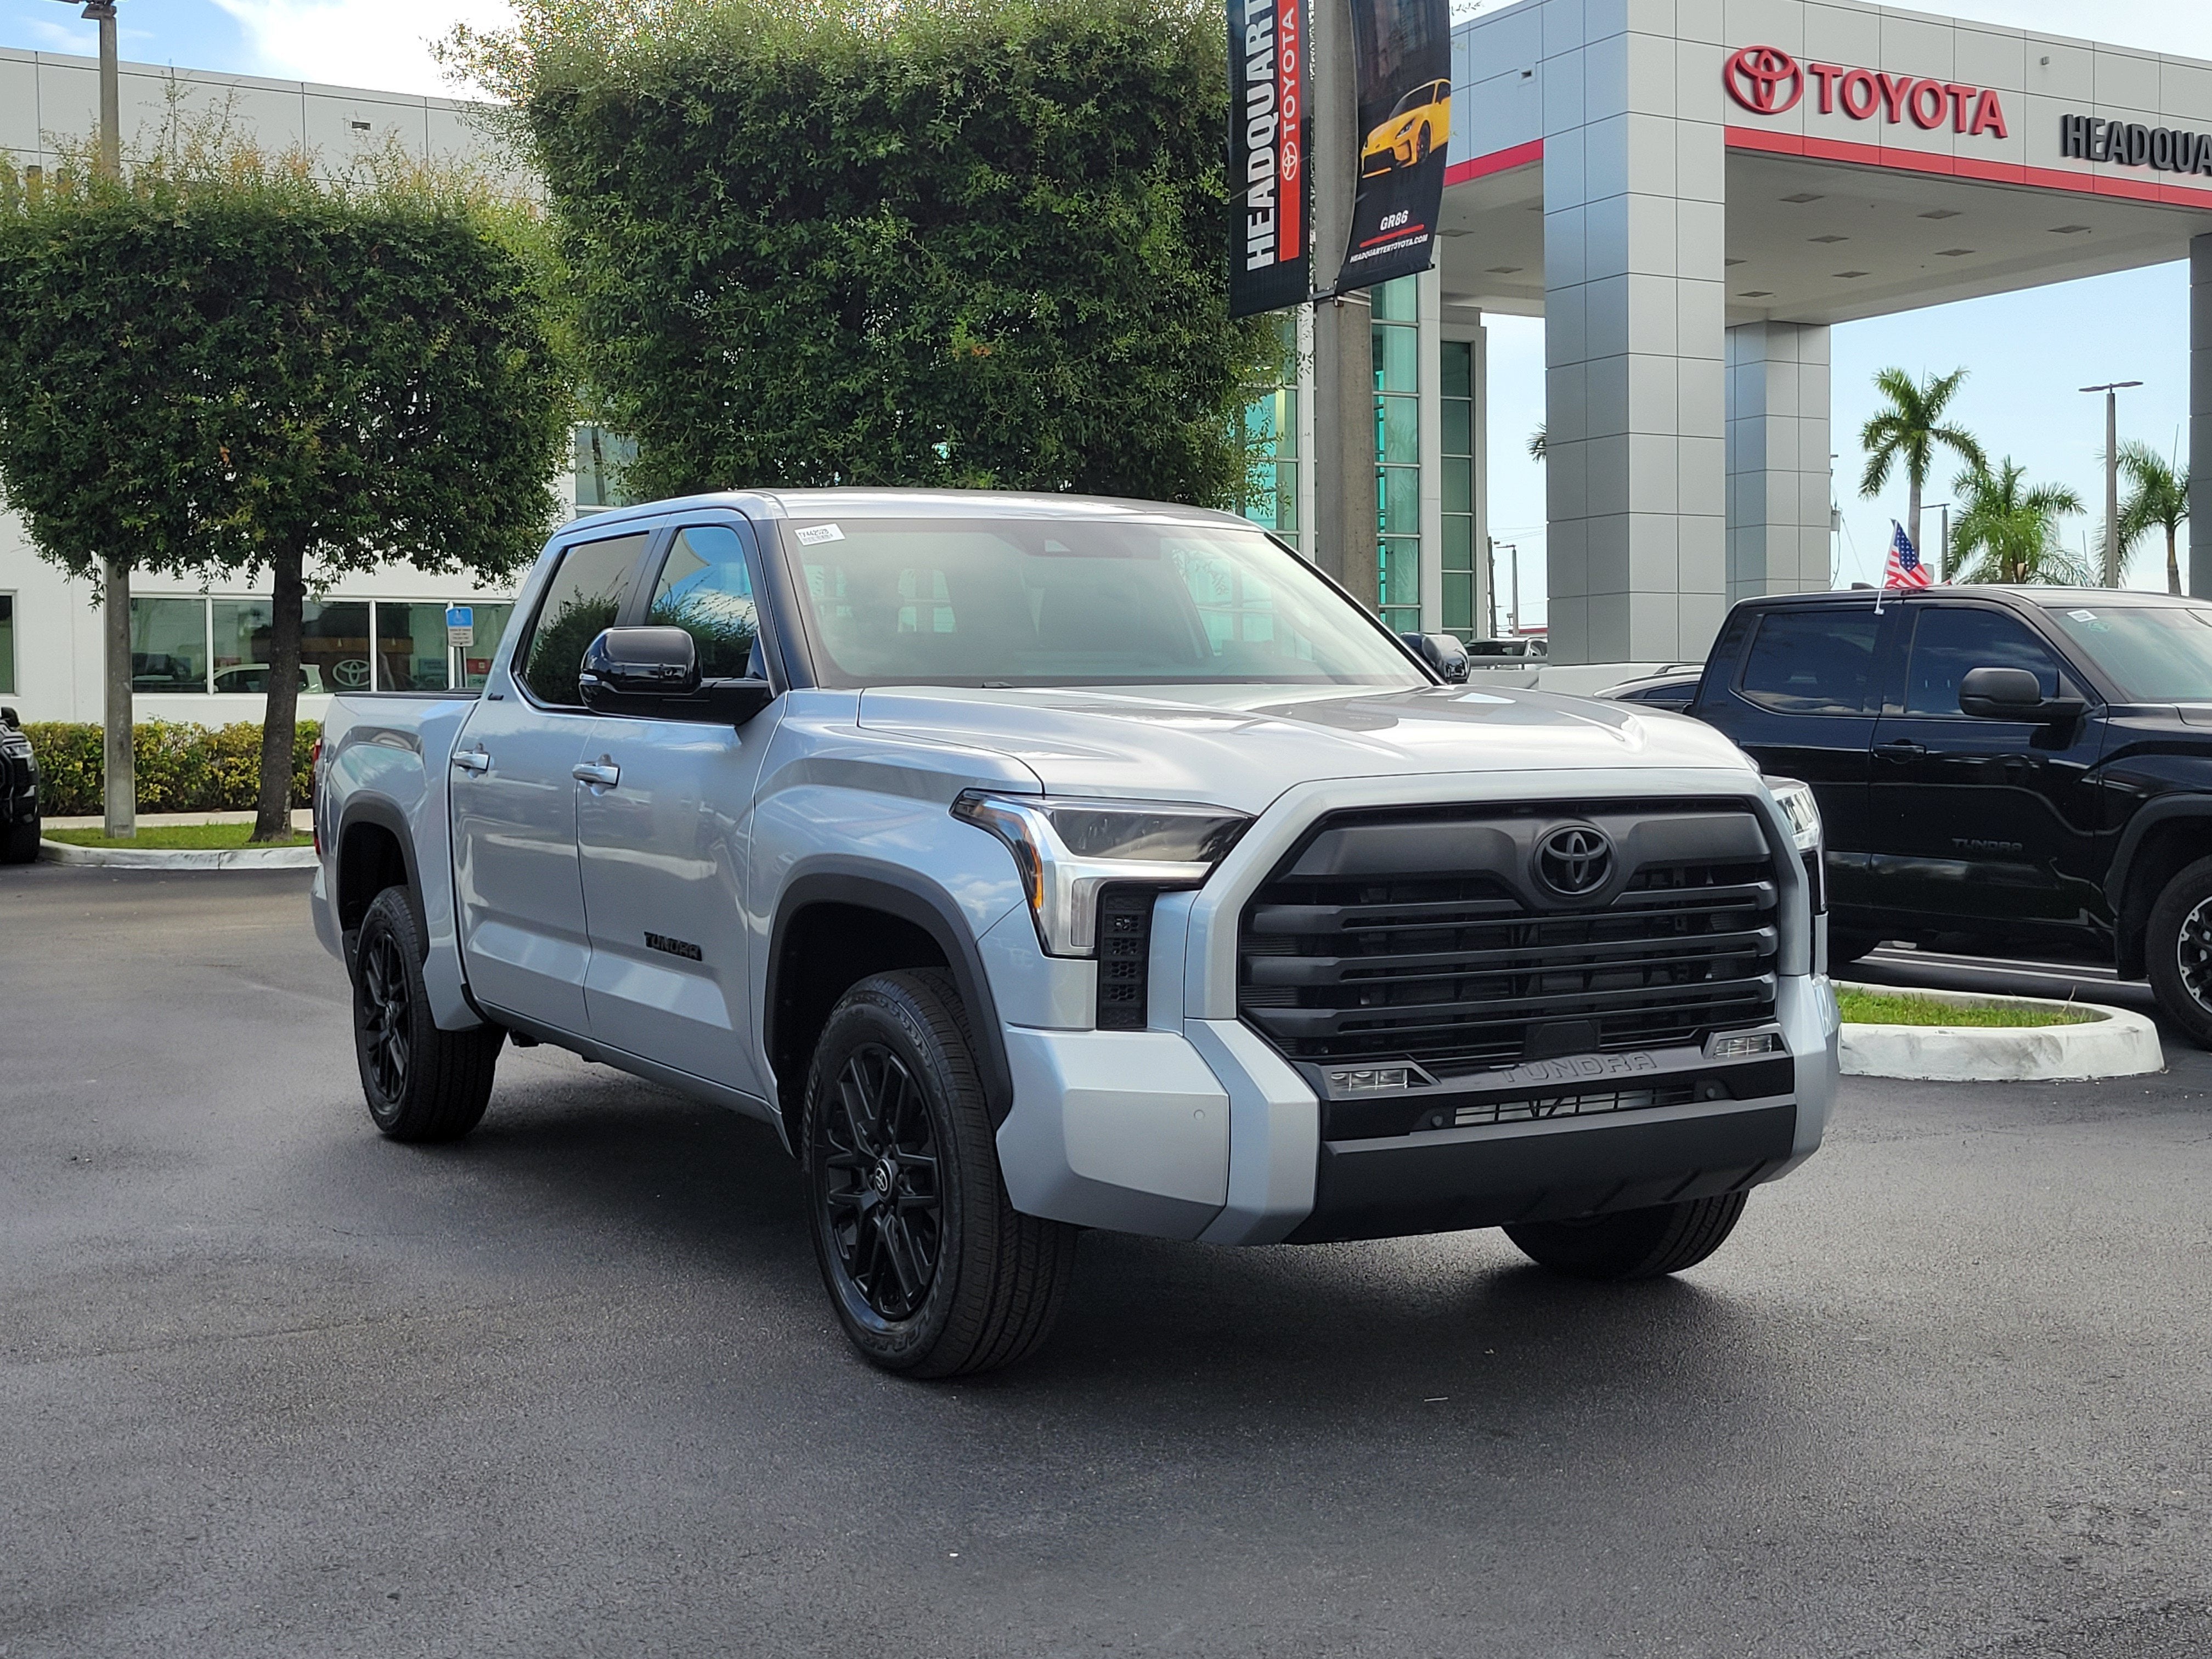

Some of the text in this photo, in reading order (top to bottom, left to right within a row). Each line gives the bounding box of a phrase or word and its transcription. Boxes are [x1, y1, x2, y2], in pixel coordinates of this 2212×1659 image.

[1282, 7, 1295, 139] TOYOTA
[1809, 63, 2008, 139] TOYOTA
[1244, 0, 1278, 271] HEADQUART
[2062, 113, 2212, 176] HEADQUA
[1380, 210, 1409, 230] GR86
[644, 931, 702, 962] TUNDRA
[1489, 1052, 1657, 1082] TUNDRA
